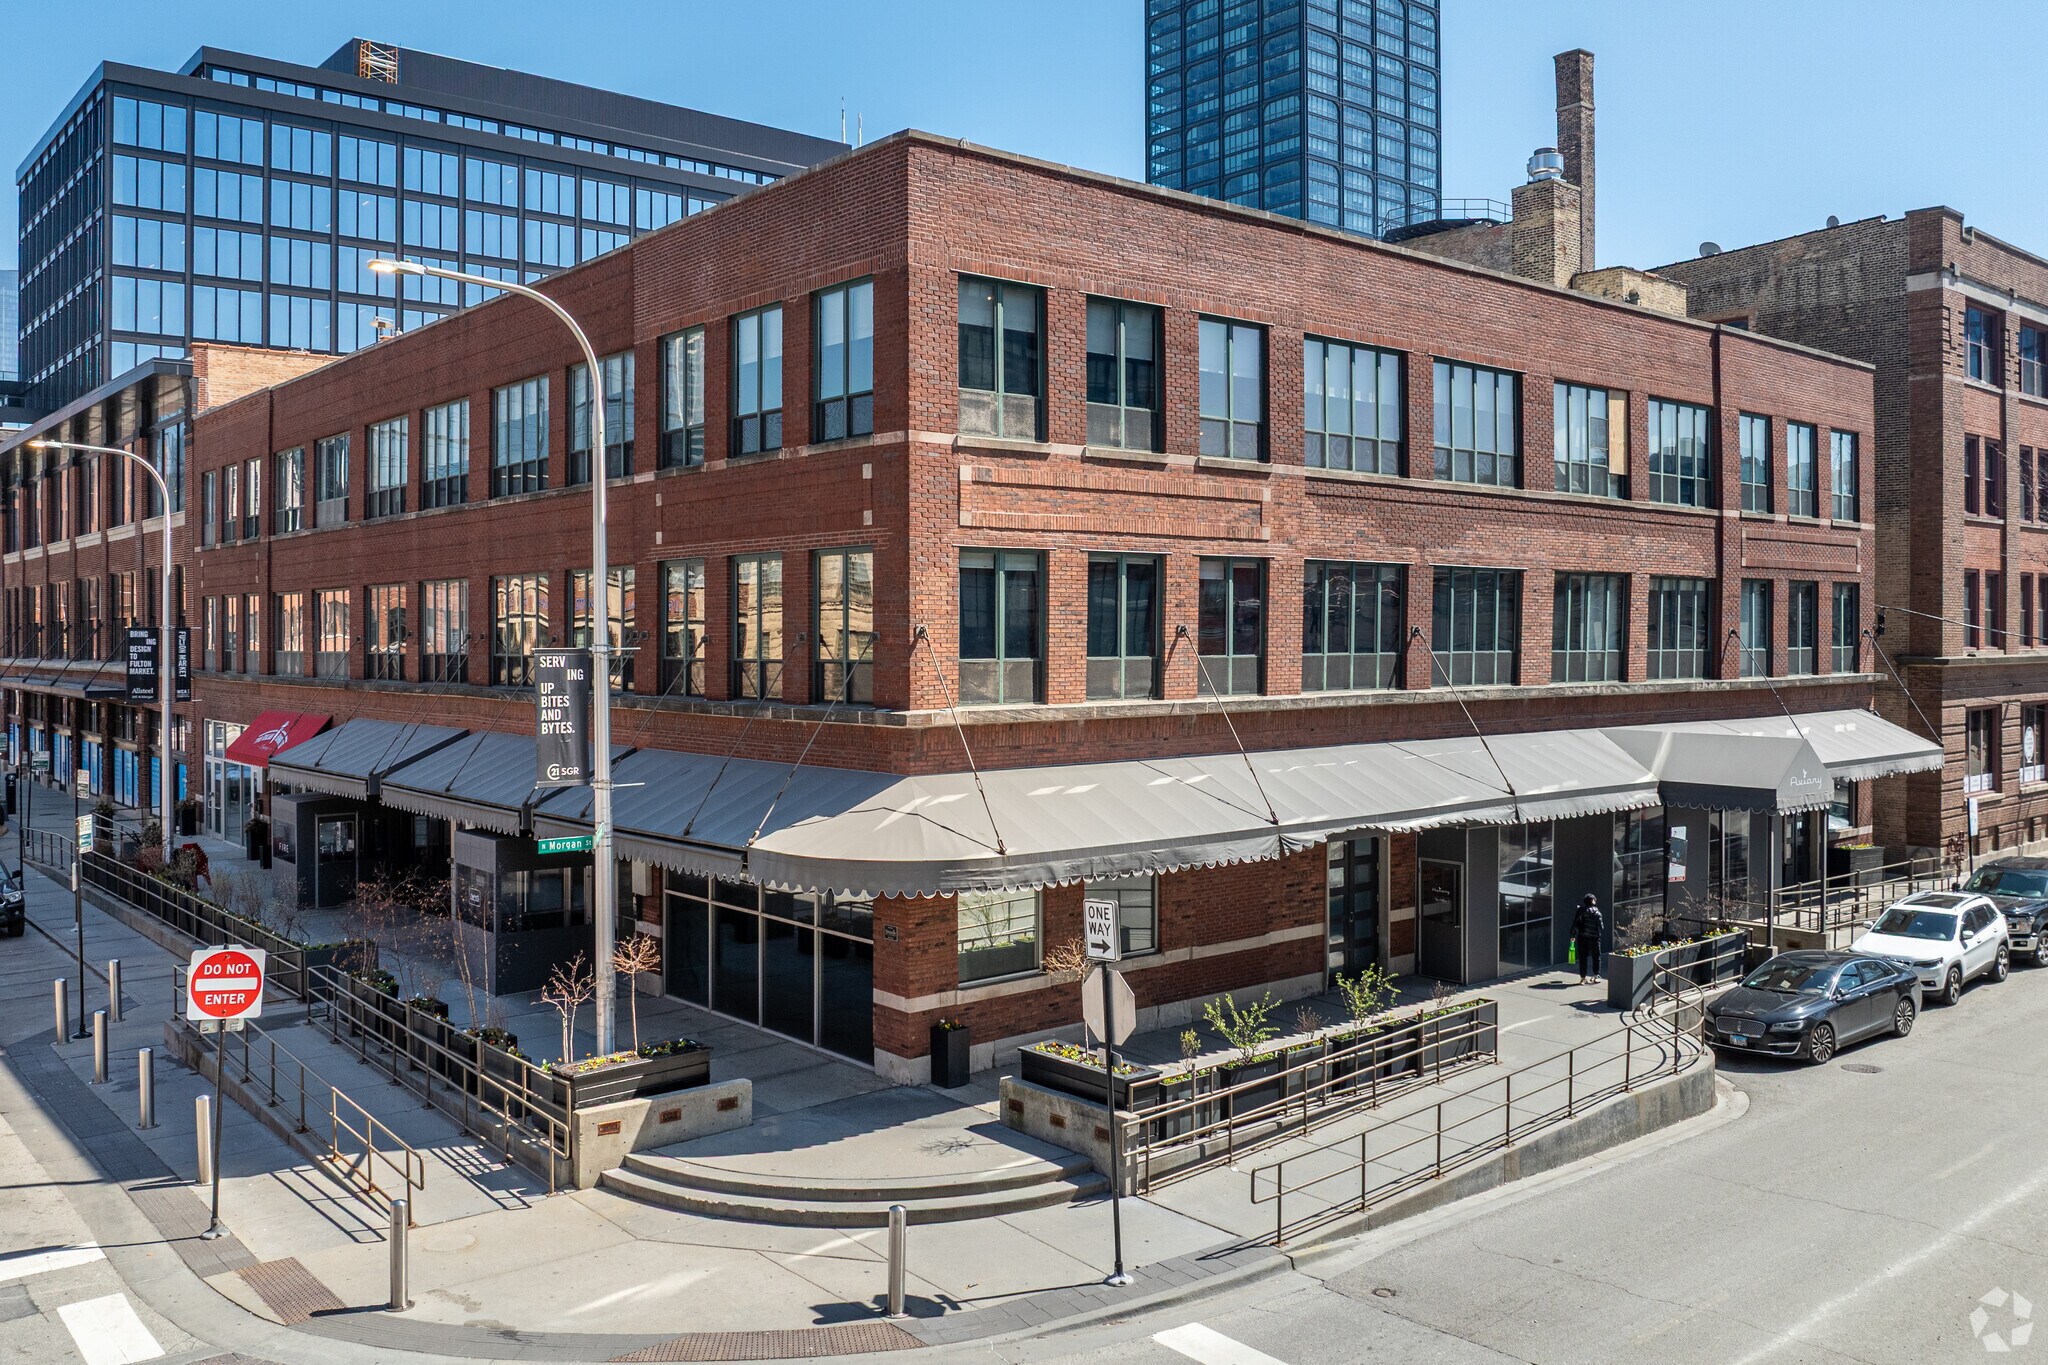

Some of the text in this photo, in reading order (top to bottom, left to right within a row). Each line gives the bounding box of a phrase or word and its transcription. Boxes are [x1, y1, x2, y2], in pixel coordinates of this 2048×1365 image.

[178, 654, 187, 677] MARKET
[540, 656, 566, 668] SERV
[567, 669, 584, 680] ING
[540, 682, 554, 694] UP
[541, 696, 570, 708] BITES
[541, 709, 561, 721] AND
[541, 722, 575, 735] BYTES.
[561, 767, 579, 775] SGR
[1790, 776, 1822, 789] Aviary
[549, 840, 582, 850] Morgan
[1088, 906, 1110, 920] ONE
[1088, 921, 1111, 936] WAY
[204, 963, 252, 975] DO NOT
[205, 993, 246, 1005] ENTER
